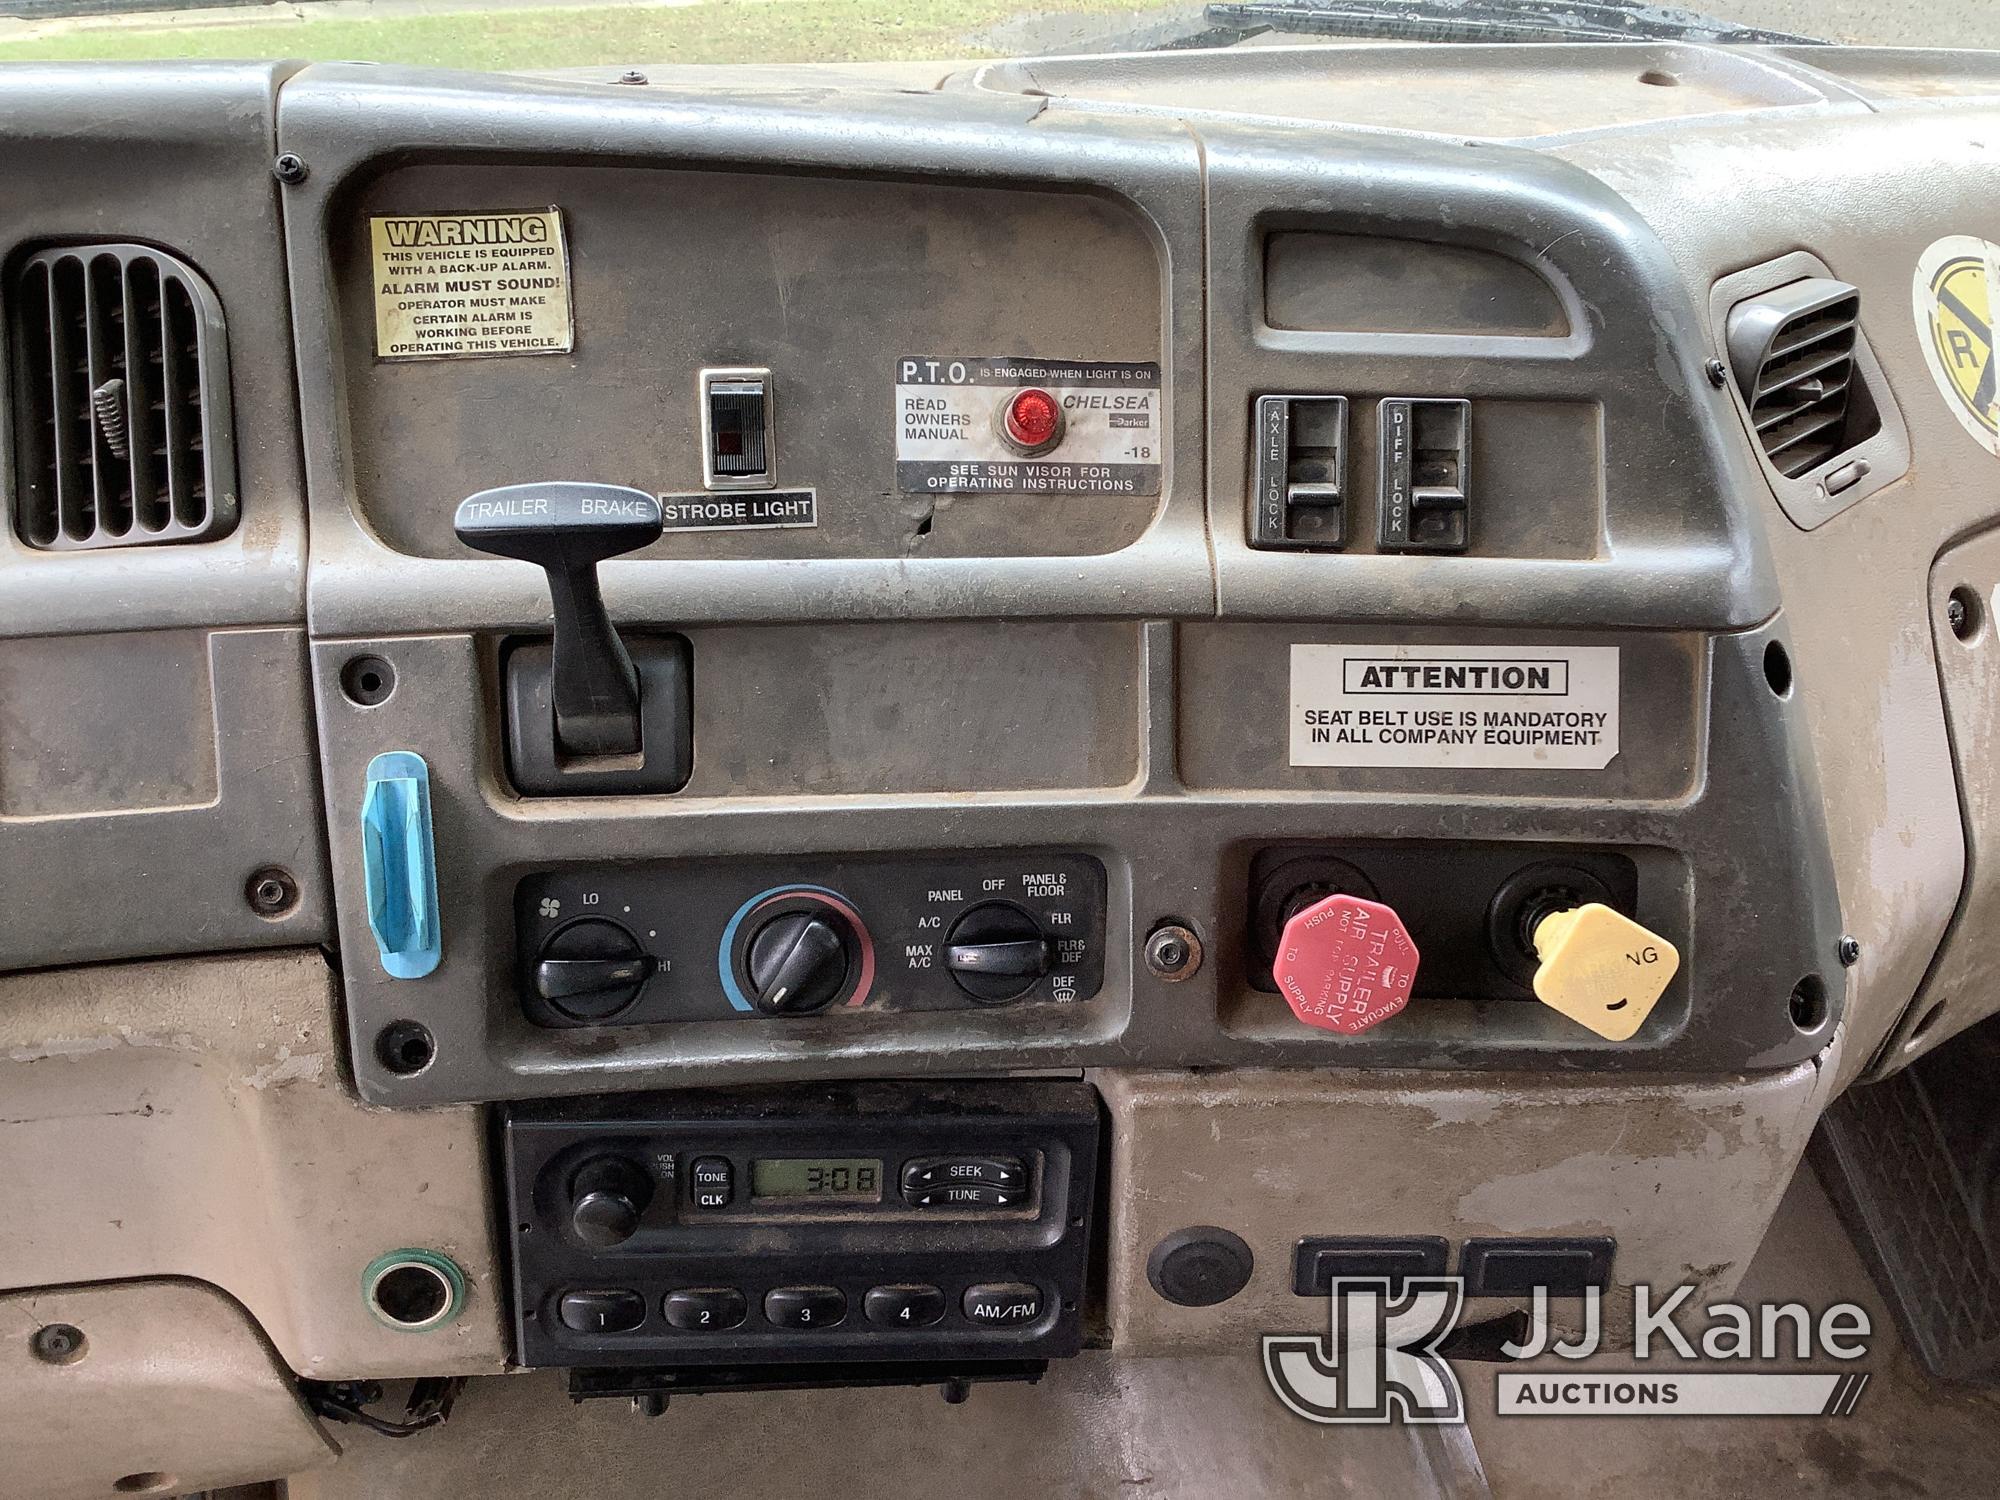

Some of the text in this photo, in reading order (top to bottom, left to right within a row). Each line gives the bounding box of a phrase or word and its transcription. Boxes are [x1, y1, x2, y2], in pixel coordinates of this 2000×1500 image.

[386, 216, 546, 247] WARNING
[383, 247, 555, 262] THIS VEHICLE IS EQUIPPED
[388, 261, 552, 276] WITH A BACK-UP ALARM.
[382, 277, 560, 294] ALARM MUST SOUND!
[398, 296, 546, 310] OPERATOR MUST MAKE
[413, 312, 533, 325] CERTAIN ALARM IS
[416, 326, 532, 338] WORKING BEFORE
[390, 338, 559, 353] OPERATING THIS VEHICLE.
[1946, 330, 1980, 368] R
[902, 361, 1151, 384] P.T.O. IS ENGAGED WHEN LIGHT IS ON
[905, 399, 946, 411] READ
[905, 413, 971, 425] OWNERS
[1115, 417, 1148, 427] Parker
[905, 428, 968, 440] MANUAL
[1124, 447, 1150, 458] -18
[950, 465, 1110, 478] SEE SUN VISOR FOR
[1268, 410, 1280, 528] AXLE LOCK
[1392, 412, 1403, 531] DIFF LOCK
[927, 477, 1134, 491] OPERATING INSTRUCTIONS
[467, 499, 648, 520] TRAILER BRAKE
[665, 501, 811, 520] STROBE LIGHT
[1361, 666, 1550, 689] ATTENTION
[1305, 711, 1608, 728] SEAT BELT USE IS MANDATORY
[1312, 728, 1600, 745] IN ALL COMPANY EQUIPMENT
[982, 879, 1005, 891] OFF
[1022, 873, 1067, 886] PANEL &
[928, 890, 963, 902] PANEL
[1027, 885, 1065, 897] FLOOR
[583, 893, 599, 905] LO
[918, 917, 941, 928] A/C
[1051, 913, 1072, 924] FLR
[1339, 910, 1352, 933] NOT
[1352, 907, 1370, 941] AIR
[905, 945, 932, 957] MAX
[1062, 951, 1082, 963] DEF
[658, 960, 671, 972] HI
[908, 957, 931, 969] A/C
[1284, 907, 1335, 1013] PUSH TO SUPPLY
[1349, 930, 1389, 1014] TRAILER
[1053, 976, 1075, 988] DEF
[1398, 973, 1409, 988] TO
[1348, 996, 1404, 1031] EVACUATE
[657, 1154, 674, 1162] VOL
[697, 1173, 727, 1182] TONE
[950, 1165, 982, 1178] SEEK
[806, 1167, 875, 1193] 3:08
[701, 1195, 723, 1205] CLK
[948, 1189, 980, 1201] TUNE
[800, 1308, 810, 1322] 3
[900, 1307, 910, 1320] 4
[973, 1302, 1036, 1318] AM/FM
[700, 1310, 710, 1324] 2
